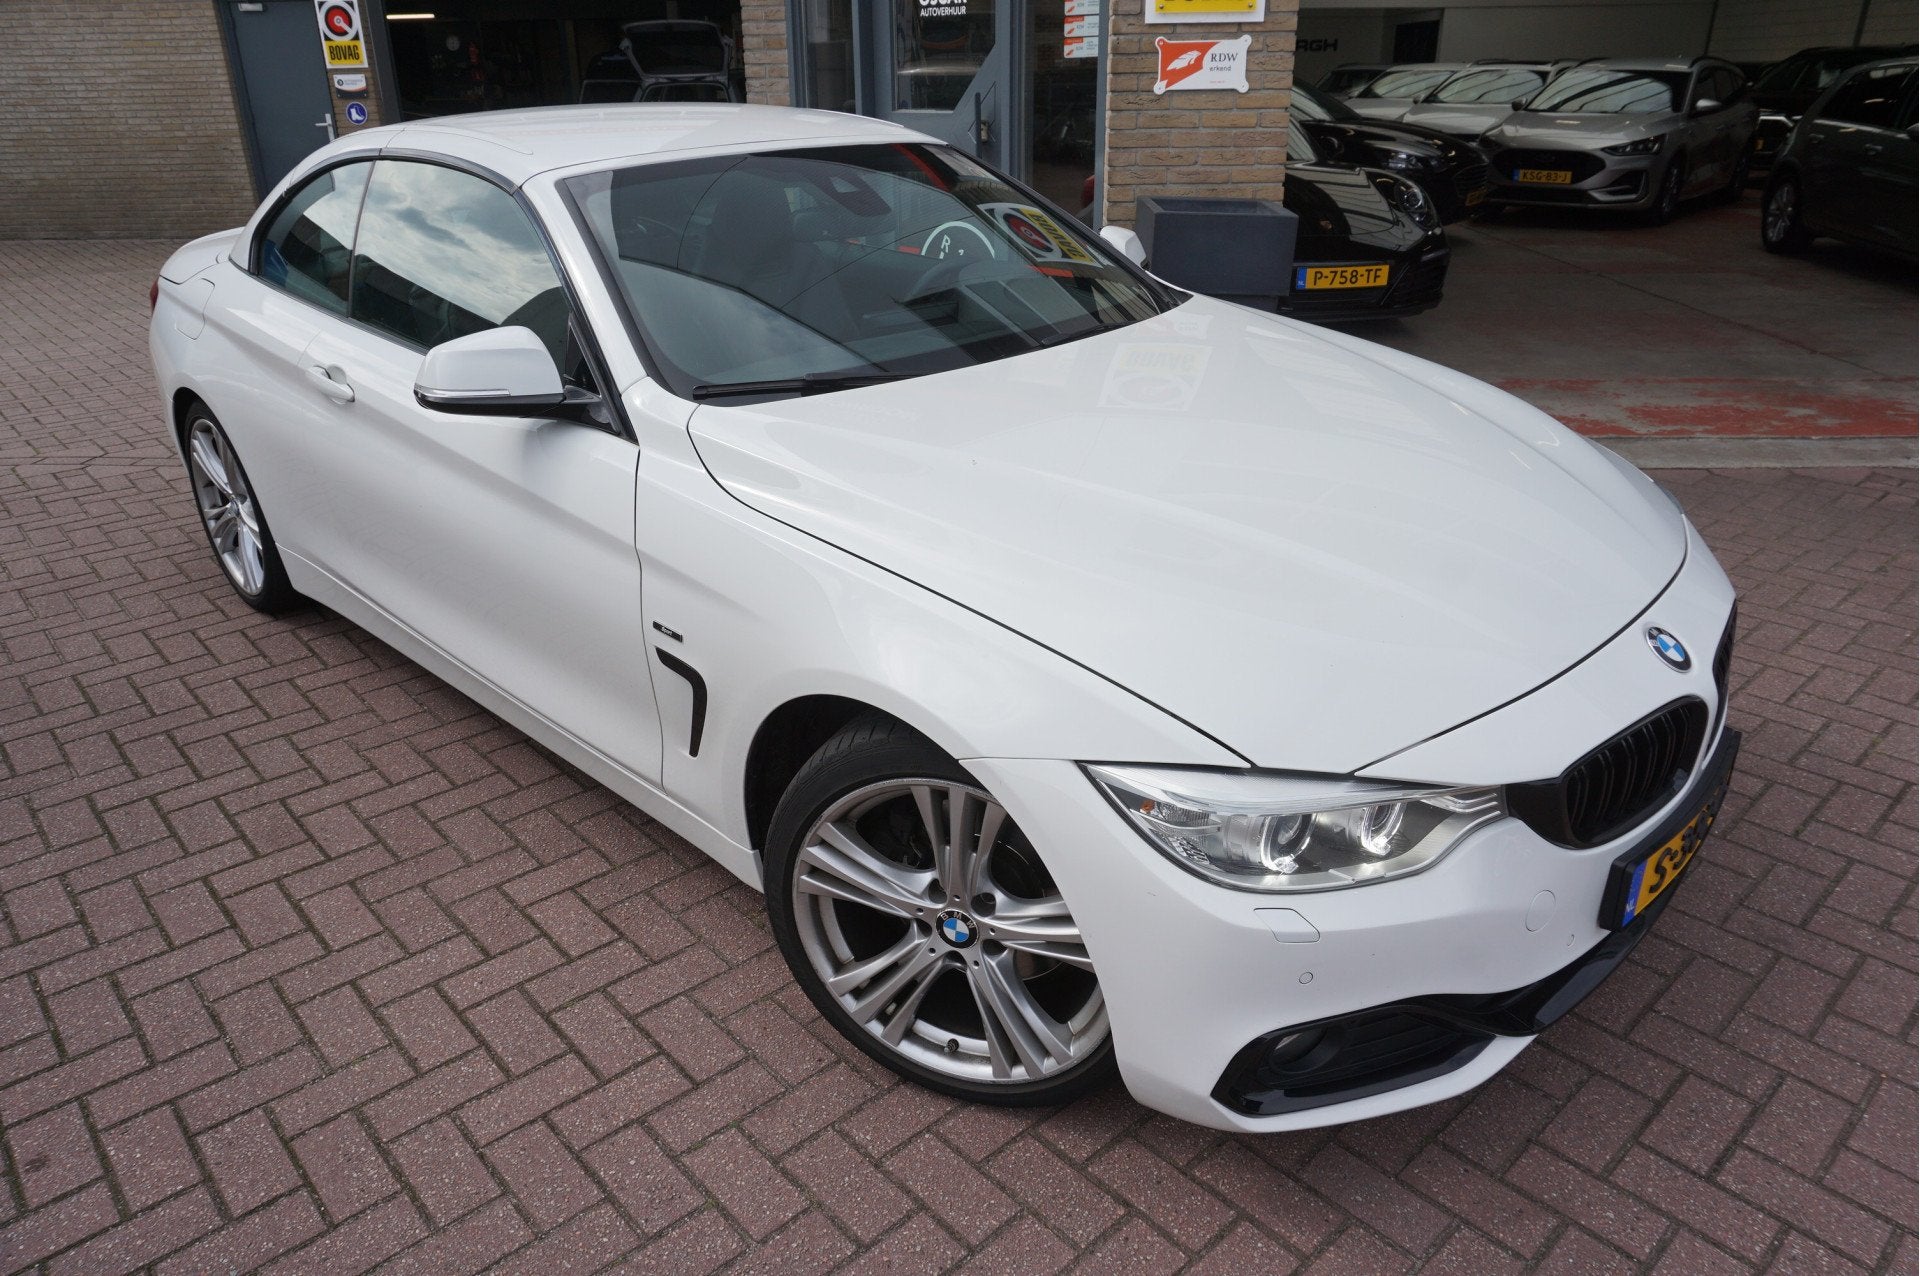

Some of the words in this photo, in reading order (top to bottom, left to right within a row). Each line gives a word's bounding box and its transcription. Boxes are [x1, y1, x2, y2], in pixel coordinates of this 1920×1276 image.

[920, 6, 966, 17] AUTOVERHUUR
[329, 44, 360, 61] BOVAG
[1210, 52, 1238, 63] RDW
[1313, 268, 1382, 286] P-758-TF
[940, 911, 976, 929] BMW
